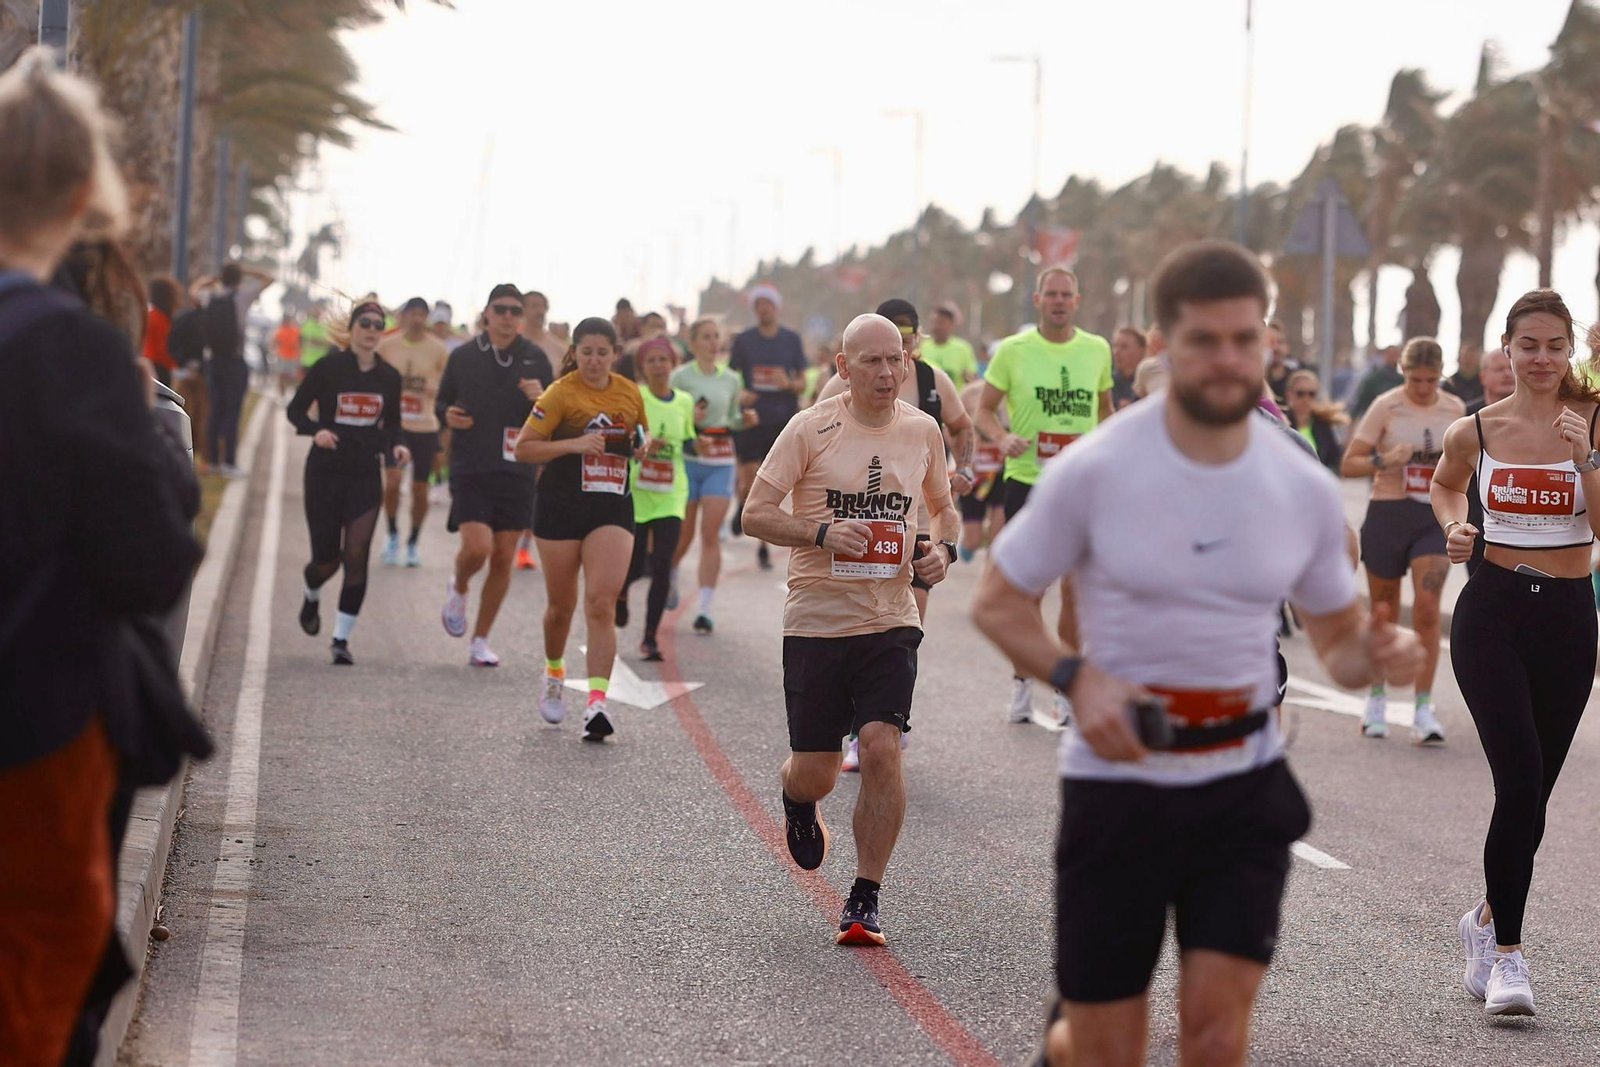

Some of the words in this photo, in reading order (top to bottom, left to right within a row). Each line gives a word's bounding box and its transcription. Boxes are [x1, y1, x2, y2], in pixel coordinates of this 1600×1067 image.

[1042, 400, 1072, 417] RUN
[1491, 484, 1528, 498] BRUNCH
[1494, 493, 1513, 503] RUN
[1530, 489, 1570, 506] 1531
[873, 540, 899, 555] 438
